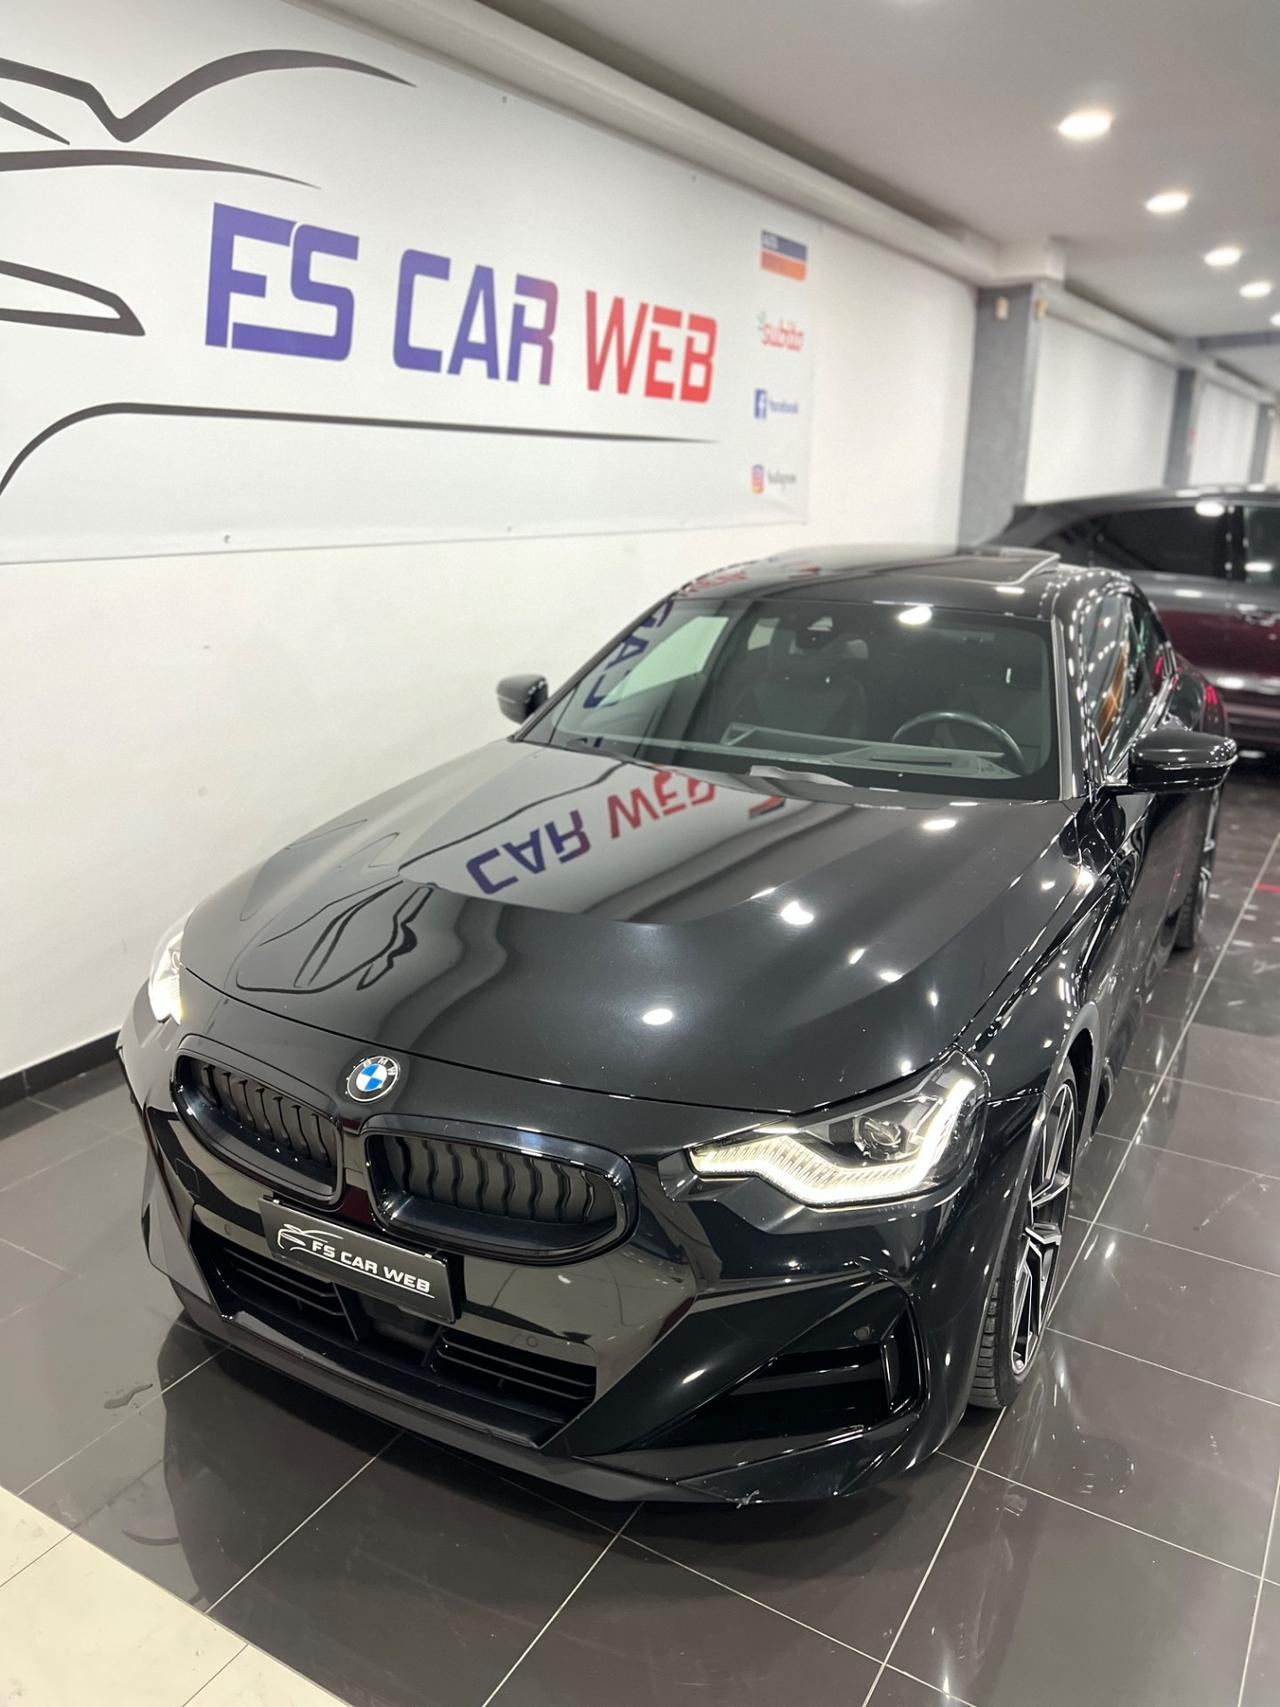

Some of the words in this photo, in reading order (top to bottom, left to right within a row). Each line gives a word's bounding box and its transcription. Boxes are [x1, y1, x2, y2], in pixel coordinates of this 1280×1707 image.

[393, 248, 558, 386] CAR
[586, 290, 718, 404] WEB
[363, 1057, 397, 1076] BMW
[311, 1239, 336, 1259] FS
[340, 1251, 378, 1275] CAR
[383, 1265, 430, 1293] WEB
